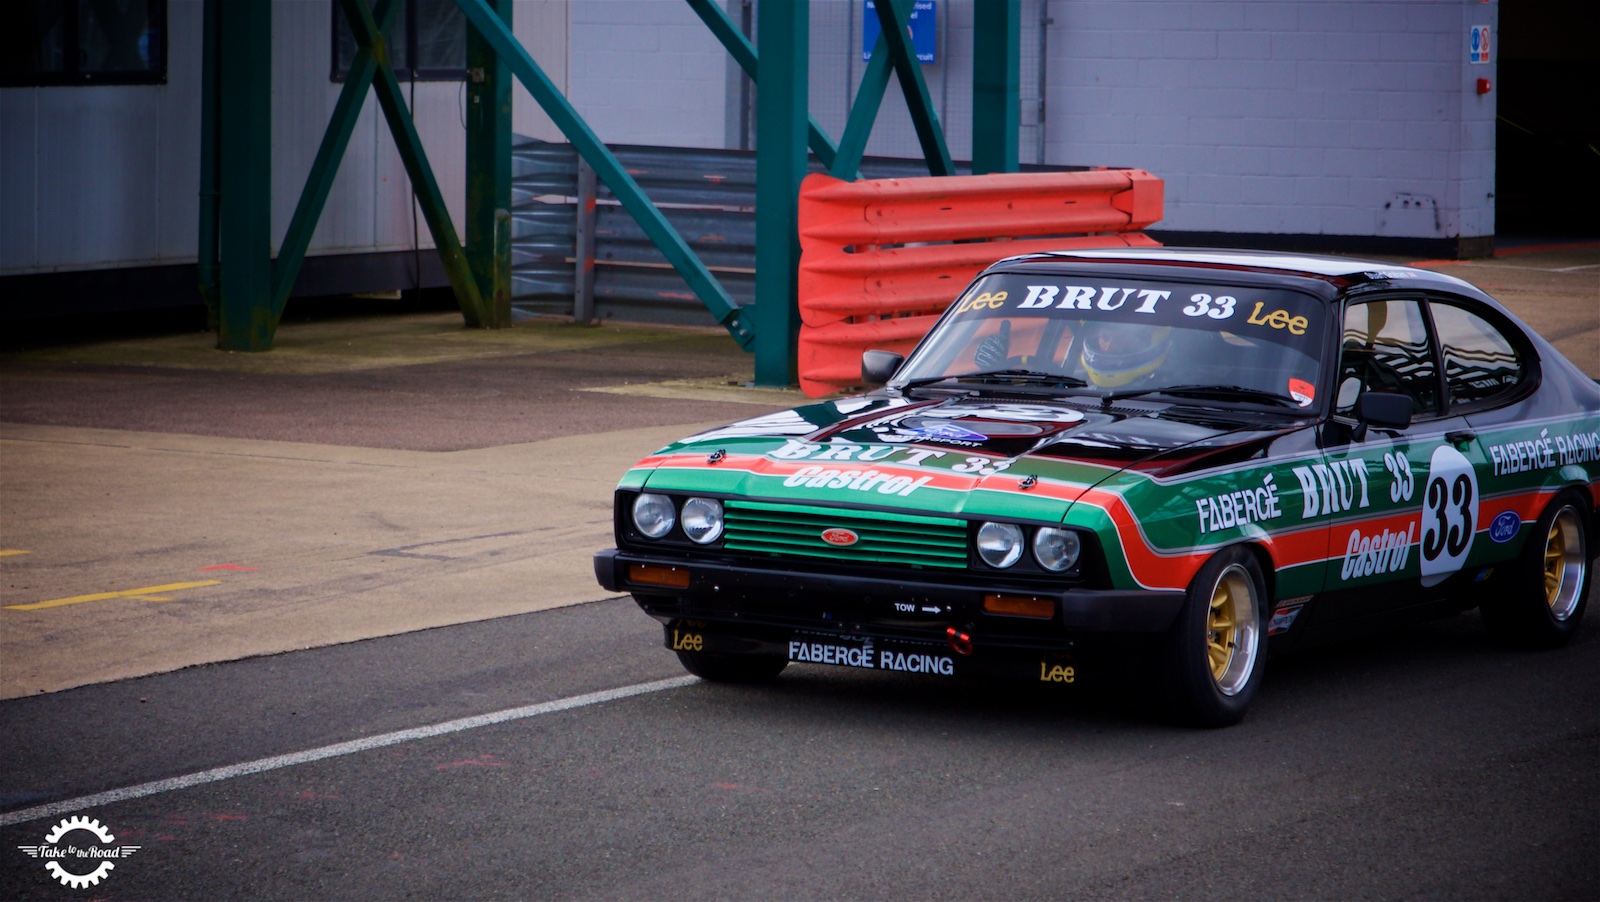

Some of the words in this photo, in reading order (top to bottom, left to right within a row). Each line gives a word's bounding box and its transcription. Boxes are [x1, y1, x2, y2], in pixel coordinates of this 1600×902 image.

[954, 291, 1008, 315] Lee
[1017, 285, 1172, 314] BRUT
[1183, 293, 1237, 320] 33
[1247, 301, 1309, 335] Lee
[766, 438, 948, 466] BRUT
[1489, 428, 1557, 477] FABERGÉ
[1555, 432, 1600, 466] RACING
[783, 466, 934, 497] Castrol
[1196, 472, 1282, 534] FABERGÉ
[1292, 457, 1371, 519] BRUT
[1383, 450, 1414, 504] 33
[1423, 474, 1472, 561] 33
[1495, 515, 1516, 537] Ford
[1340, 521, 1416, 581] Castrol
[895, 602, 915, 613] TOW
[673, 629, 703, 652] Lee
[788, 641, 874, 669] FABERGÉ
[880, 650, 954, 676] RACING
[1040, 661, 1075, 683] Lee
